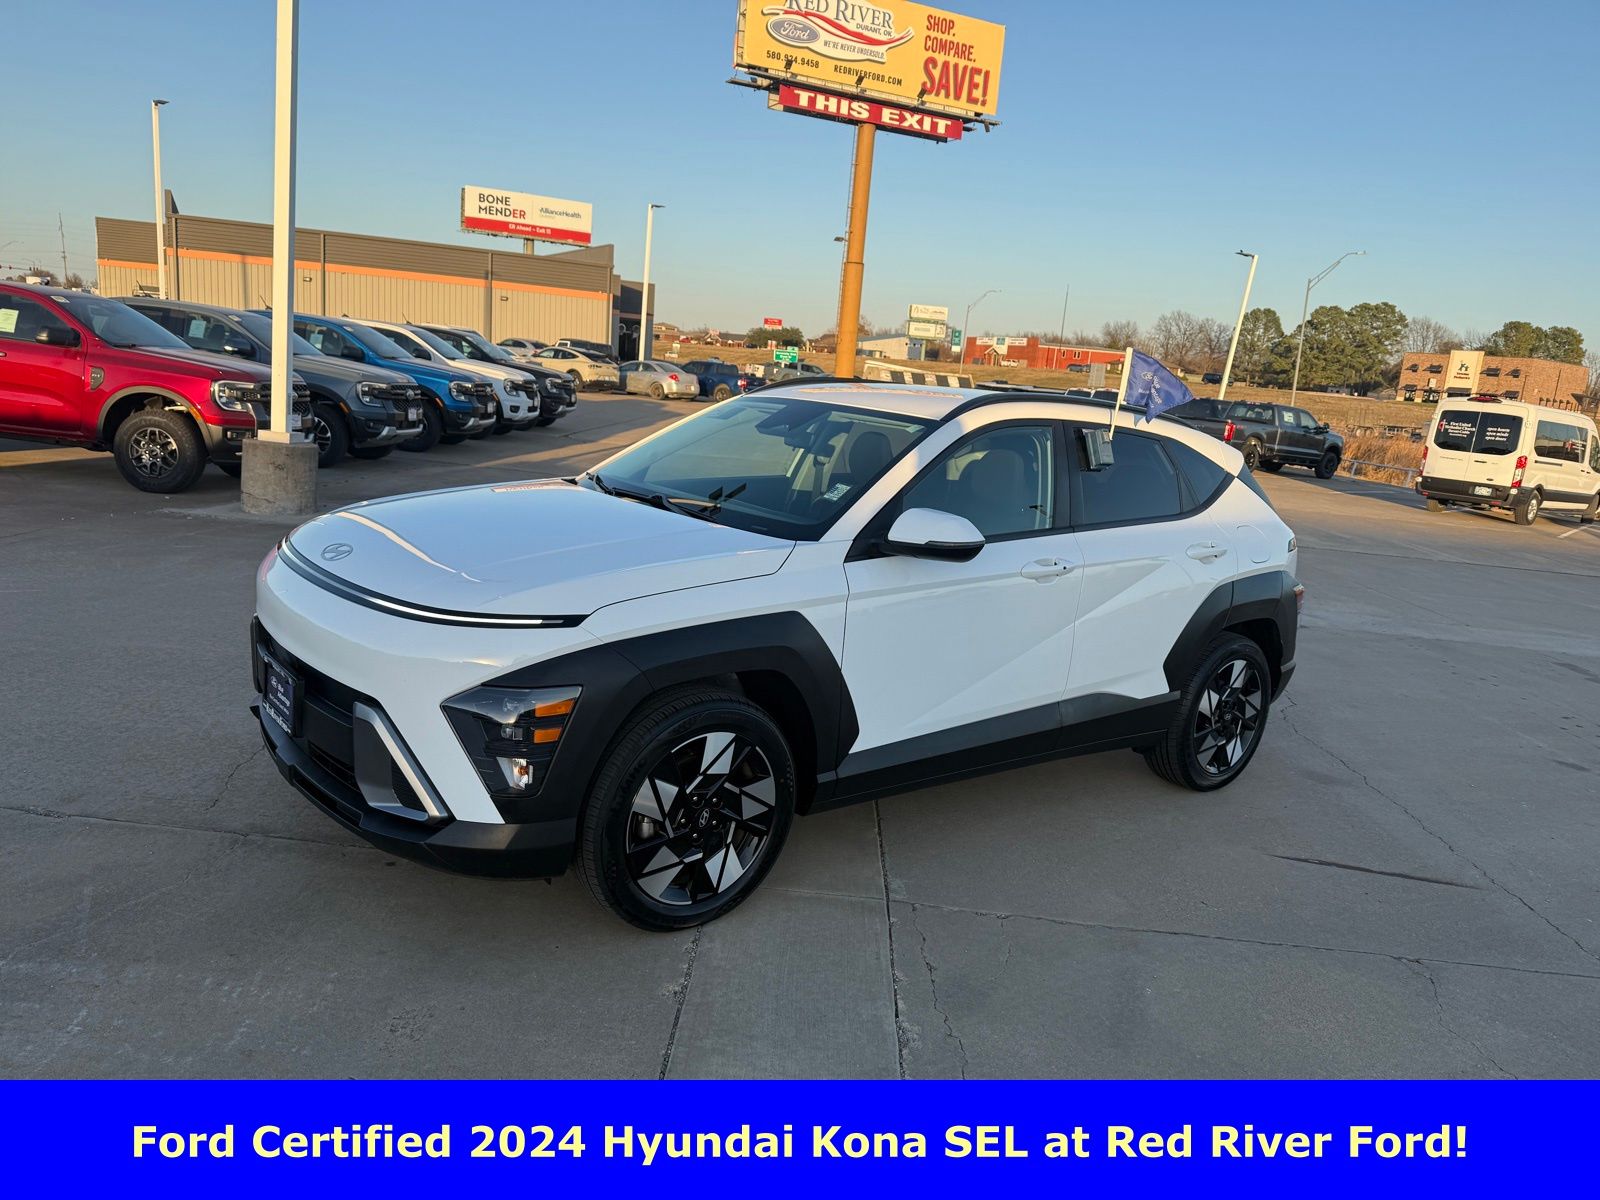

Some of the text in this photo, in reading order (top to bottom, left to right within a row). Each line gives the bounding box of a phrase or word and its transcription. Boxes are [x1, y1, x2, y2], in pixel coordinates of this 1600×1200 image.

[834, 0, 893, 29] RIVER
[926, 14, 956, 37] SHOP.
[781, 20, 810, 40] Ford
[856, 23, 893, 37] DURANT, OK
[823, 39, 839, 50] WE'RE
[840, 43, 857, 53] NEVER
[924, 35, 977, 62] COMPARE.
[833, 64, 903, 87] REDRIVERFORD.COM
[921, 56, 990, 107] SAVE!
[794, 90, 952, 134] THIS EXIT
[478, 193, 511, 206] BONE
[478, 205, 526, 220] MENDER
